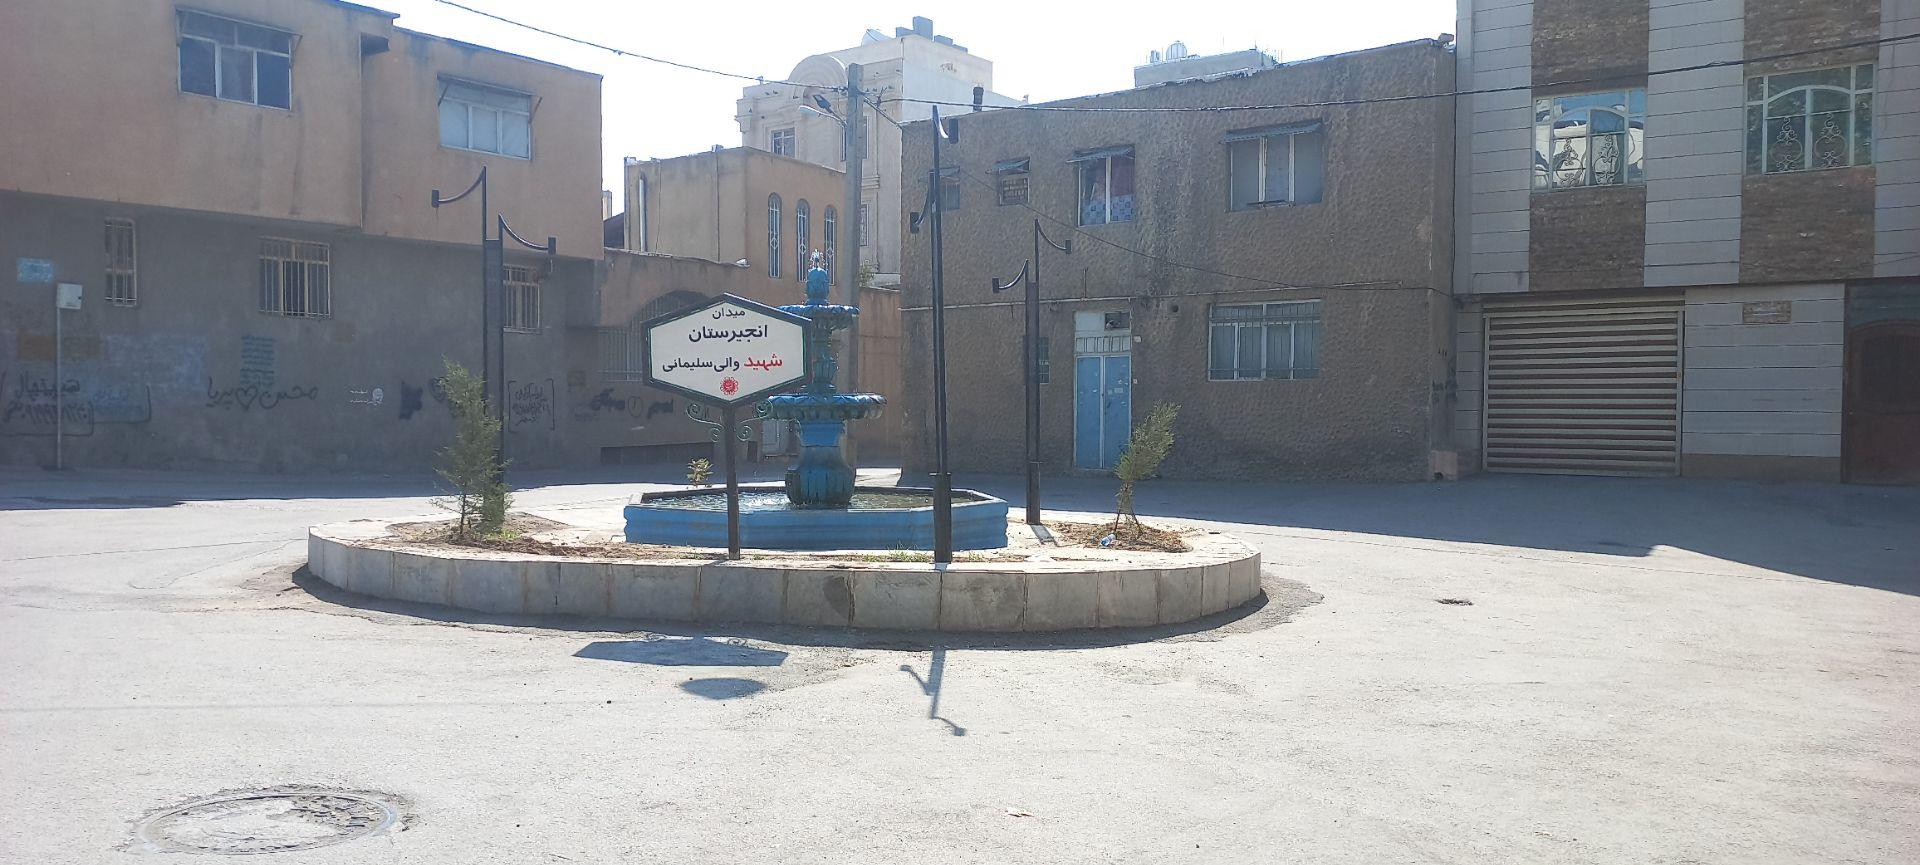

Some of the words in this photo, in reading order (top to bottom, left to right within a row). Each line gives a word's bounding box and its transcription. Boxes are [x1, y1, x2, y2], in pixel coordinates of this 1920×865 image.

[712, 307, 746, 320] میدان
[688, 324, 768, 342] انجیرستان
[662, 357, 713, 372] سلیمانی
[714, 356, 740, 372] والی
[743, 353, 783, 371] شهید
[259, 385, 318, 409] محسن
